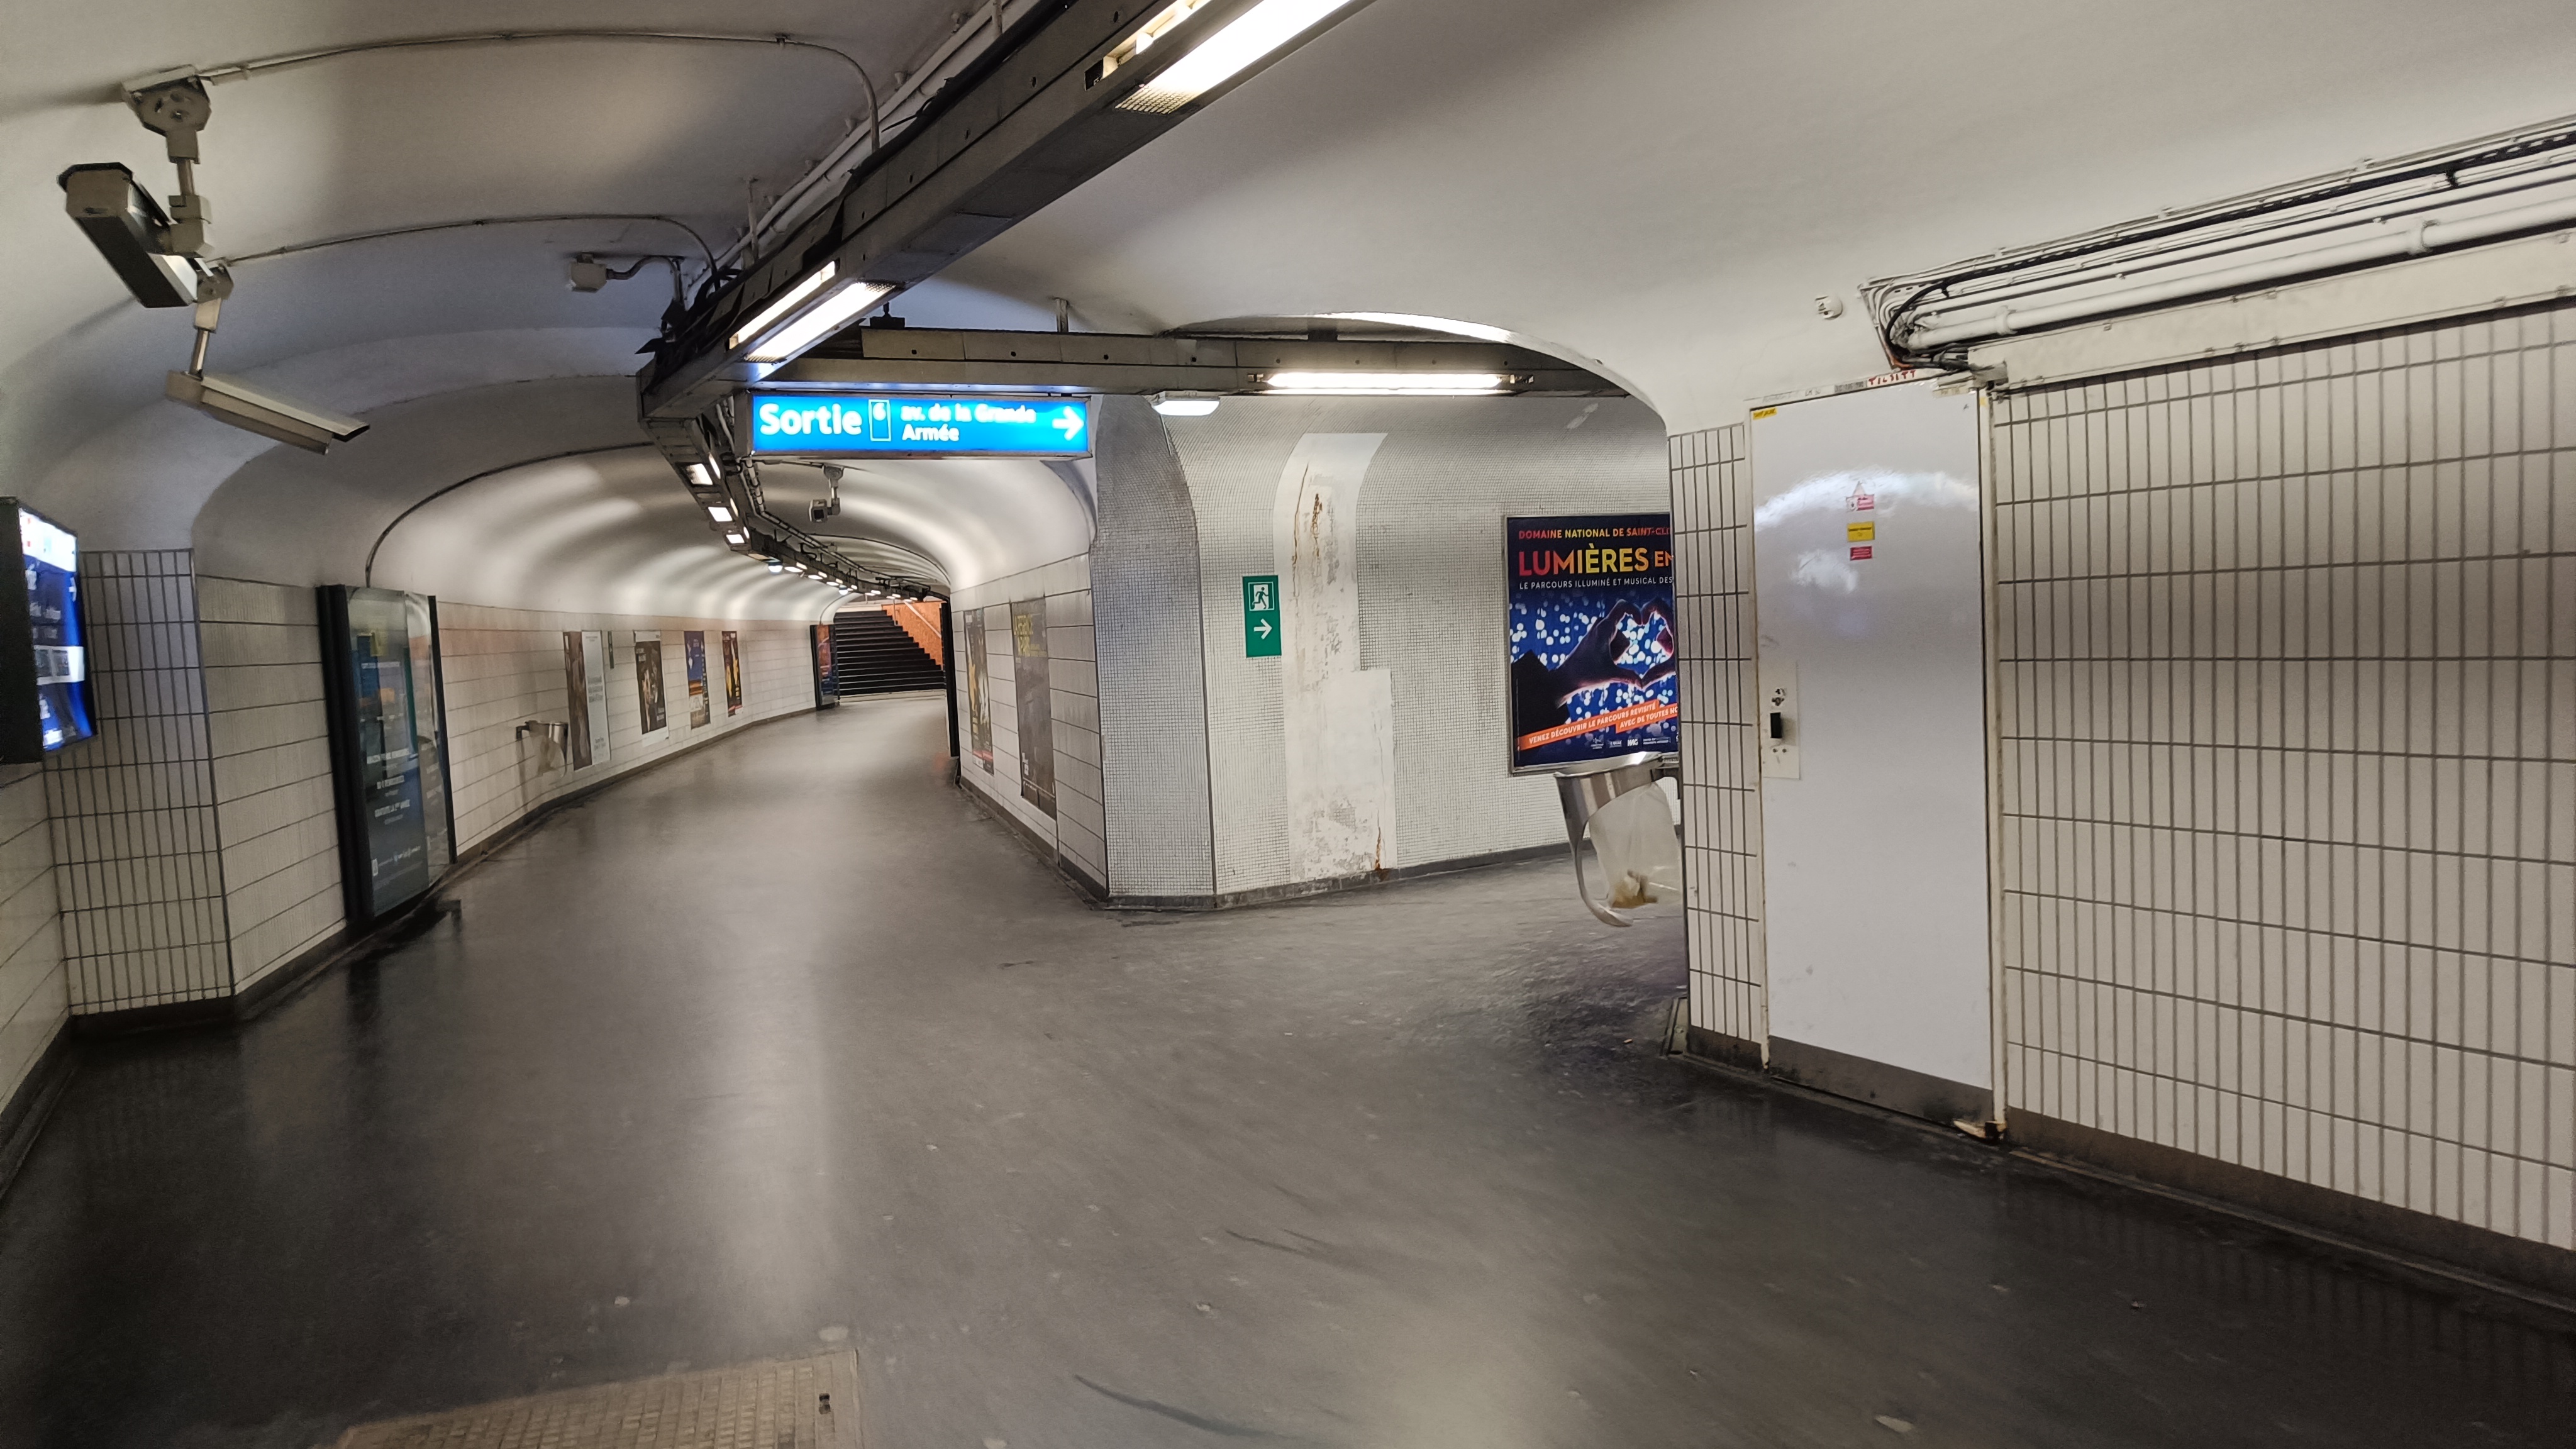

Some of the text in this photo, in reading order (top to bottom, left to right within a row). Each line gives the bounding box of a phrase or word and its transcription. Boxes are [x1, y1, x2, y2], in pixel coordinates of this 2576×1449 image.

[760, 403, 862, 435] Sortie
[872, 402, 886, 421] 6
[928, 403, 951, 421] de
[955, 403, 972, 422] la
[974, 403, 1036, 423] Grande
[902, 424, 959, 441] Armée
[1519, 529, 1562, 540] DOMAINE
[1565, 528, 1610, 538] NATIONAL
[1613, 528, 1624, 537] DE
[1519, 543, 1648, 576] LUMIÈRES
[1531, 580, 1572, 589] PARCOURS
[1575, 577, 1610, 587] ILLUMINÉ
[1624, 577, 1657, 586] MUSICAL
[1529, 735, 1549, 744] VENEZ
[1550, 723, 1587, 738] DÉCOUVRIR
[1597, 711, 1629, 725] PARCOURS
[1630, 703, 1657, 716] REVISITÉ
[1619, 719, 1636, 729] AVEC
[1646, 710, 1668, 722] TOUTES
